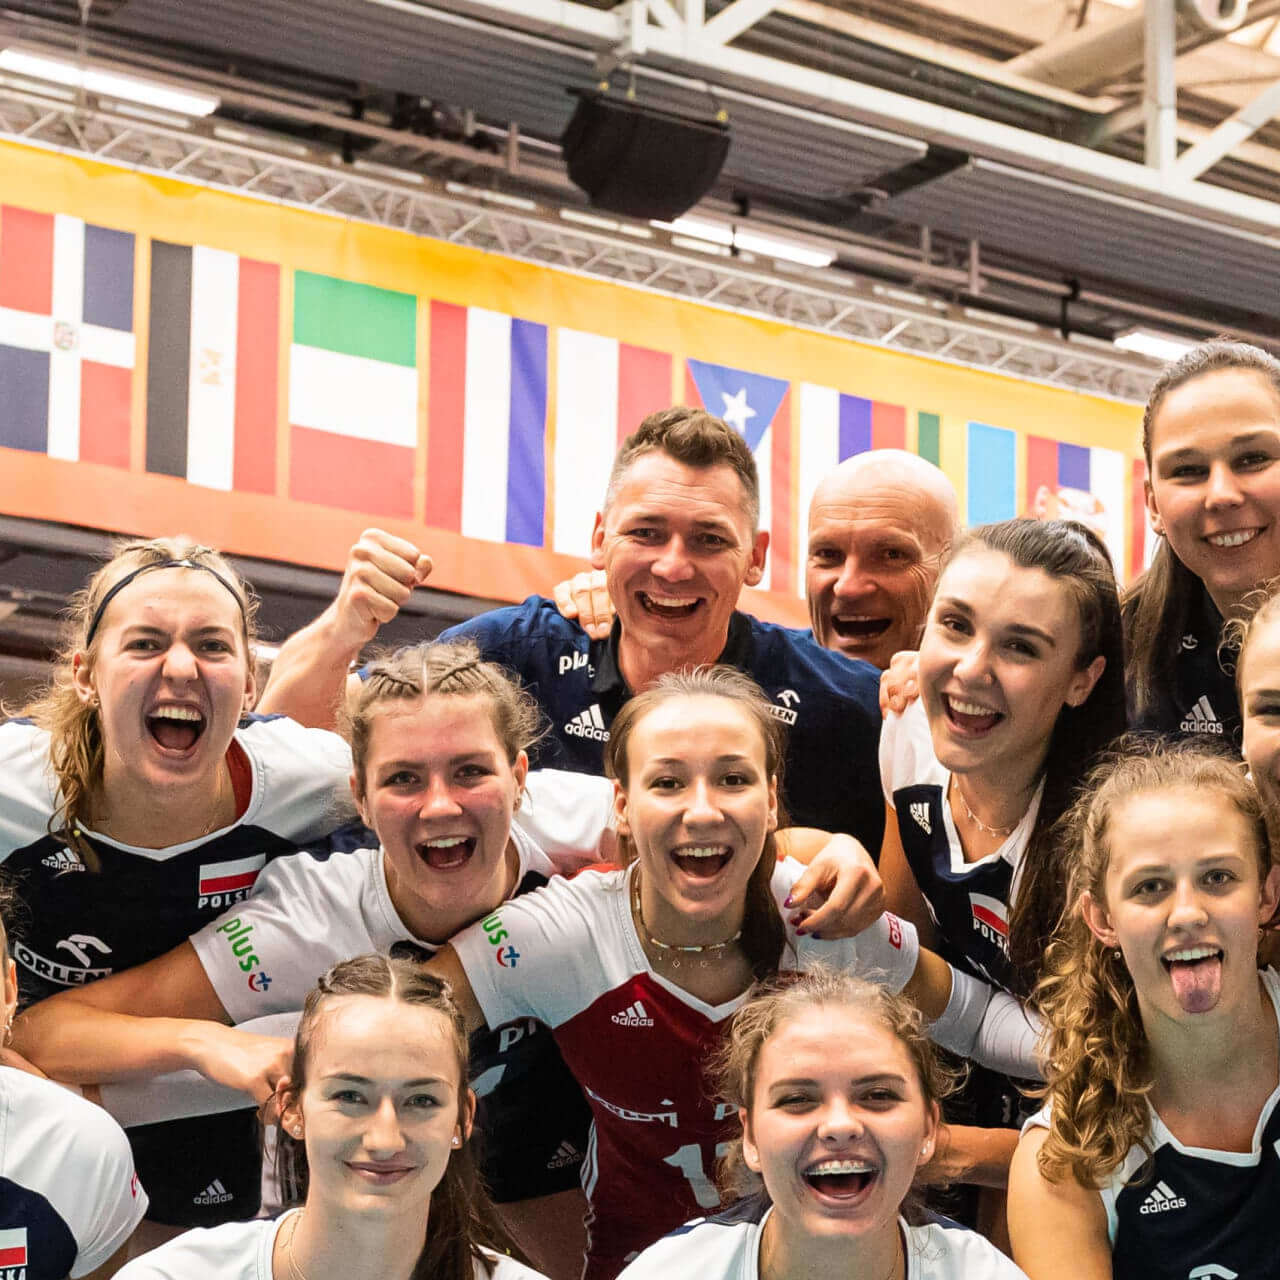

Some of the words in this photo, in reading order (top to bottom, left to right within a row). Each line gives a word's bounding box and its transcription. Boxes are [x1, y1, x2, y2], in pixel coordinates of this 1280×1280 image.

[565, 721, 611, 742] adidas
[1180, 718, 1224, 734] adidas
[216, 916, 263, 974] plus
[611, 1013, 654, 1028] adidas
[192, 1192, 234, 1205] adidas
[1139, 1197, 1187, 1215] adidas
